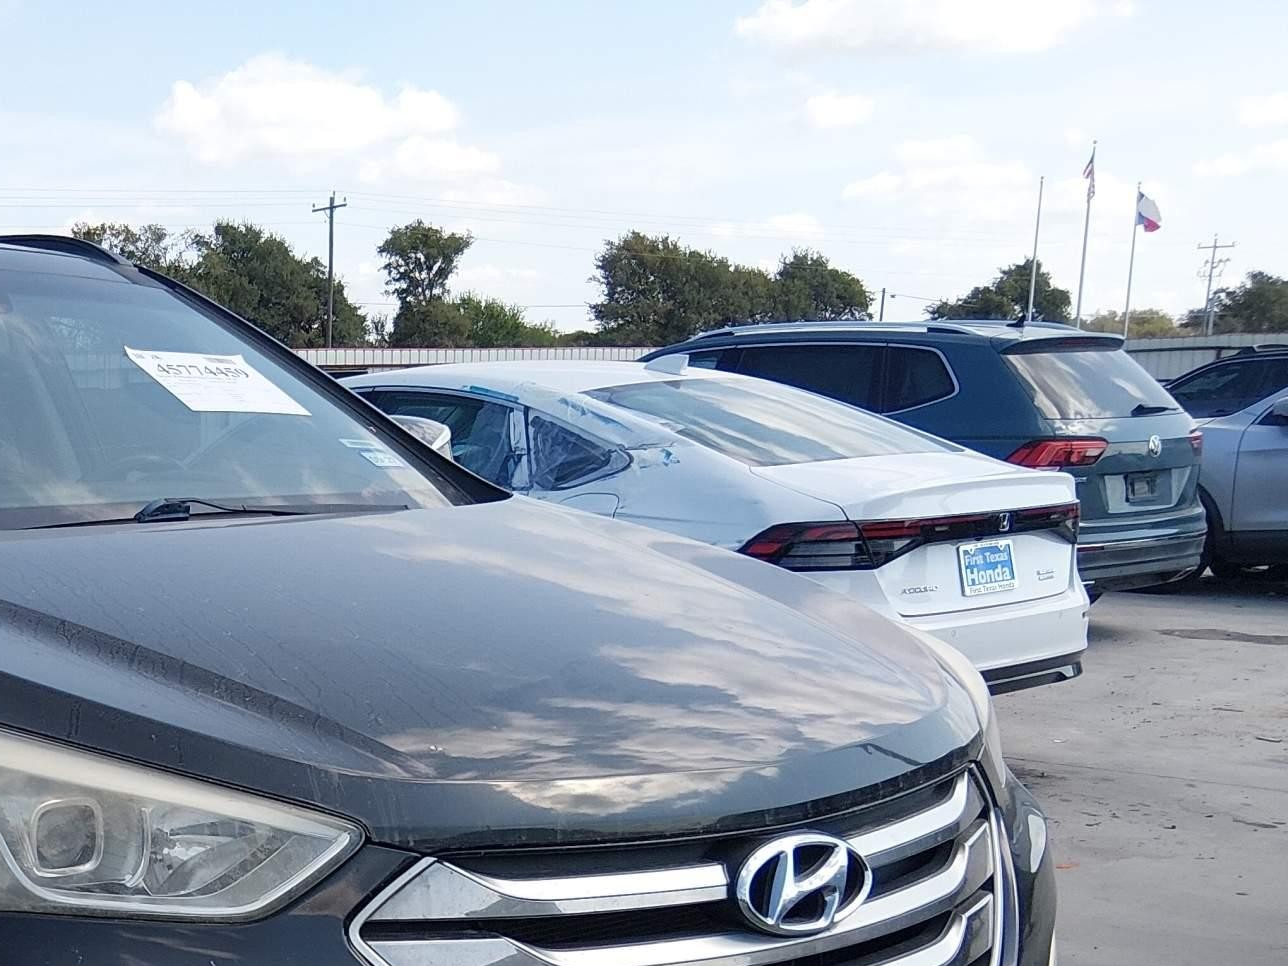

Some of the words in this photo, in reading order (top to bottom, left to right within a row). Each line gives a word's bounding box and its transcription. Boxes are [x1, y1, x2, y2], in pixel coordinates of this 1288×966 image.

[157, 363, 249, 378] 45774459
[965, 554, 984, 566] First
[984, 551, 1008, 563] Texas
[966, 564, 1012, 585] Honda
